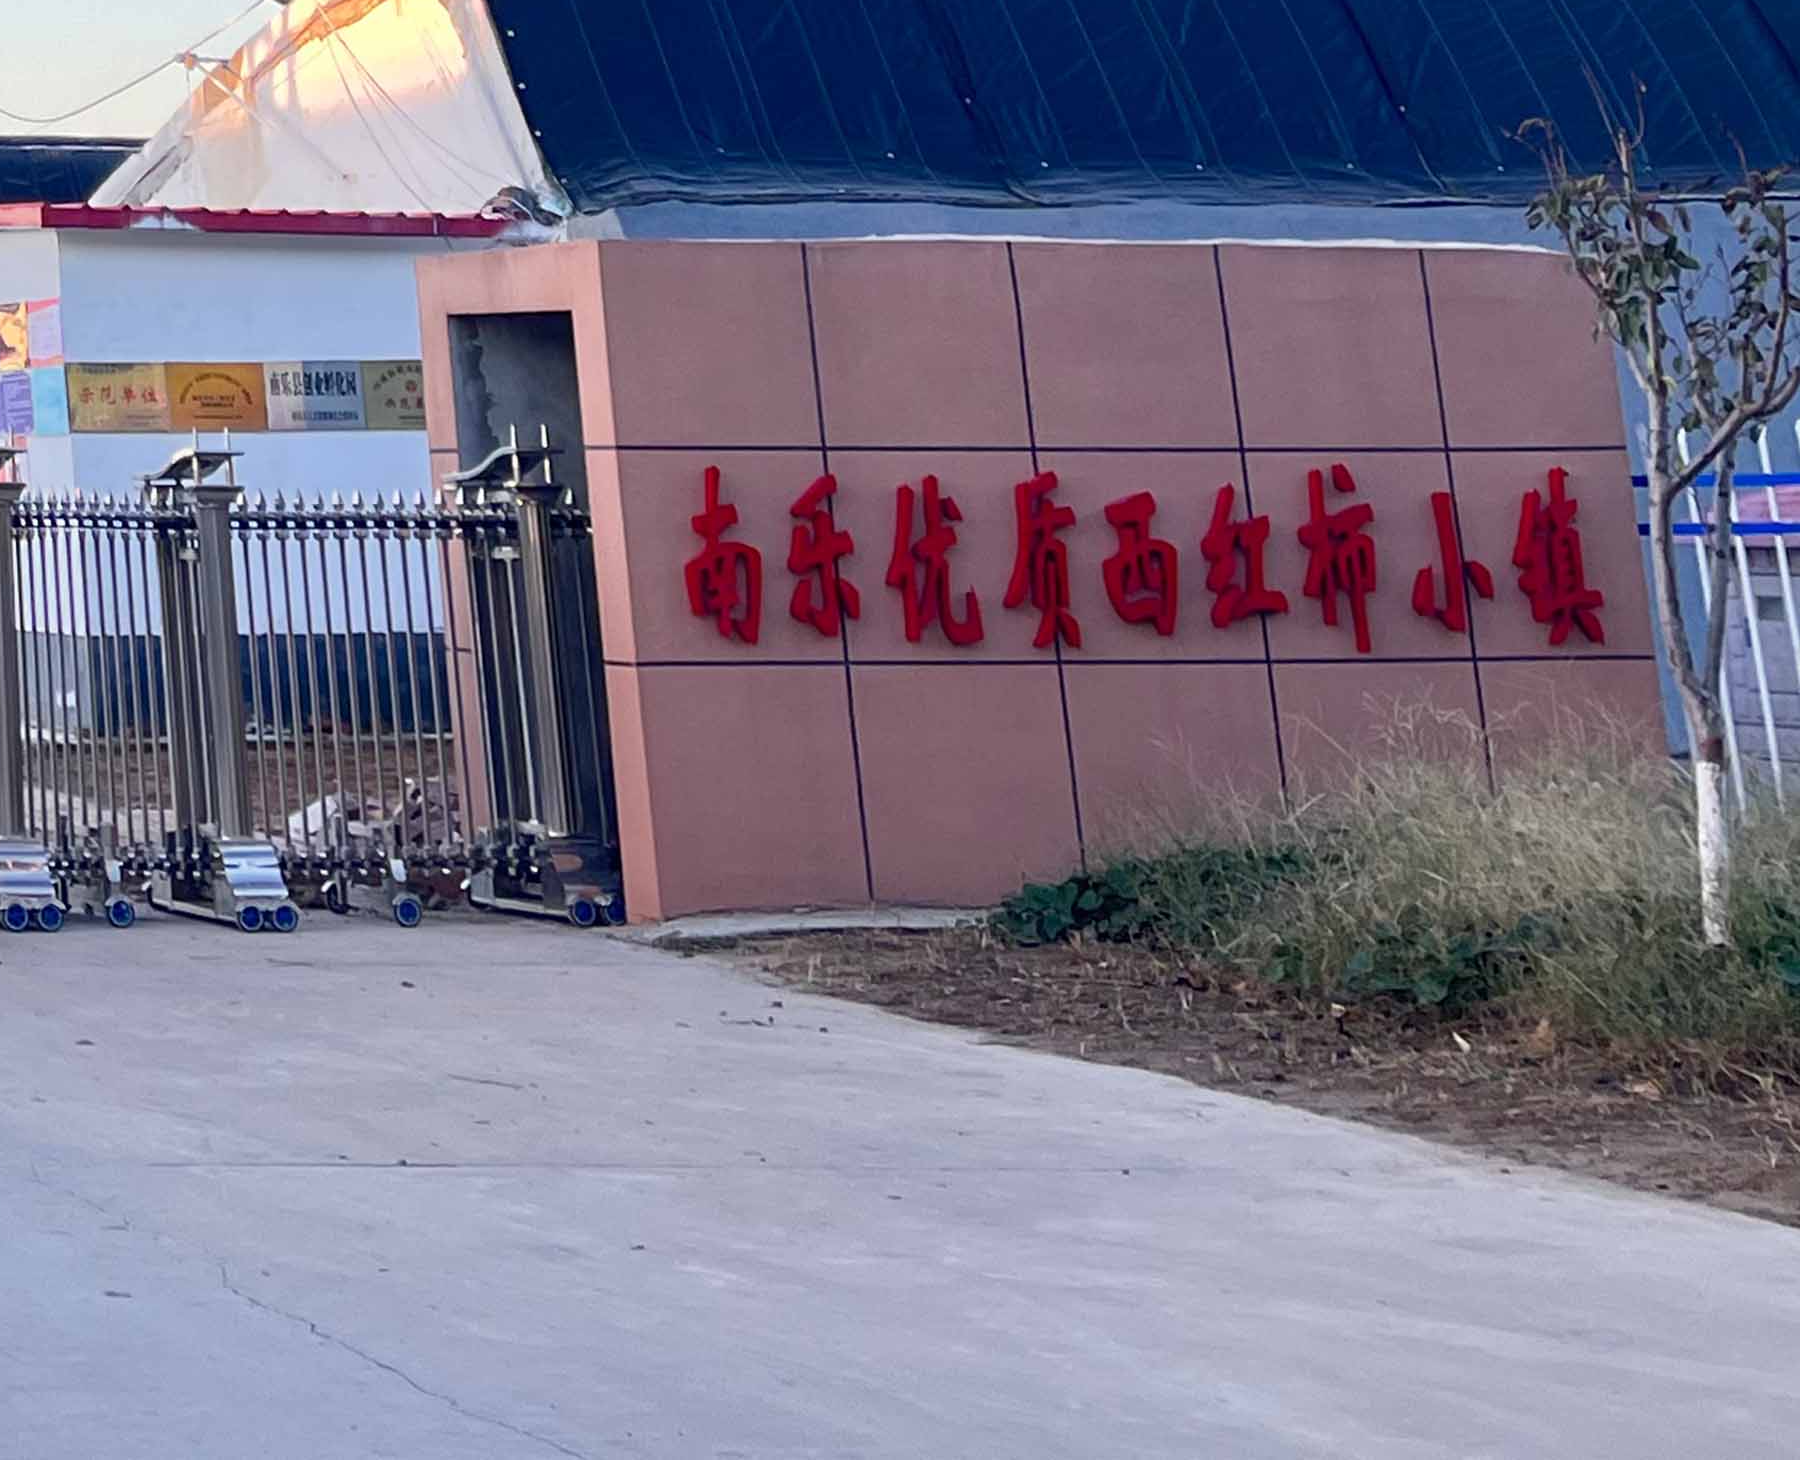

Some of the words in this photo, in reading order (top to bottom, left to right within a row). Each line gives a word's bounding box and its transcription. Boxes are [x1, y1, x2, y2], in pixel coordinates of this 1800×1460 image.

[684, 463, 1605, 653] 南乐优质西红柿小镇
